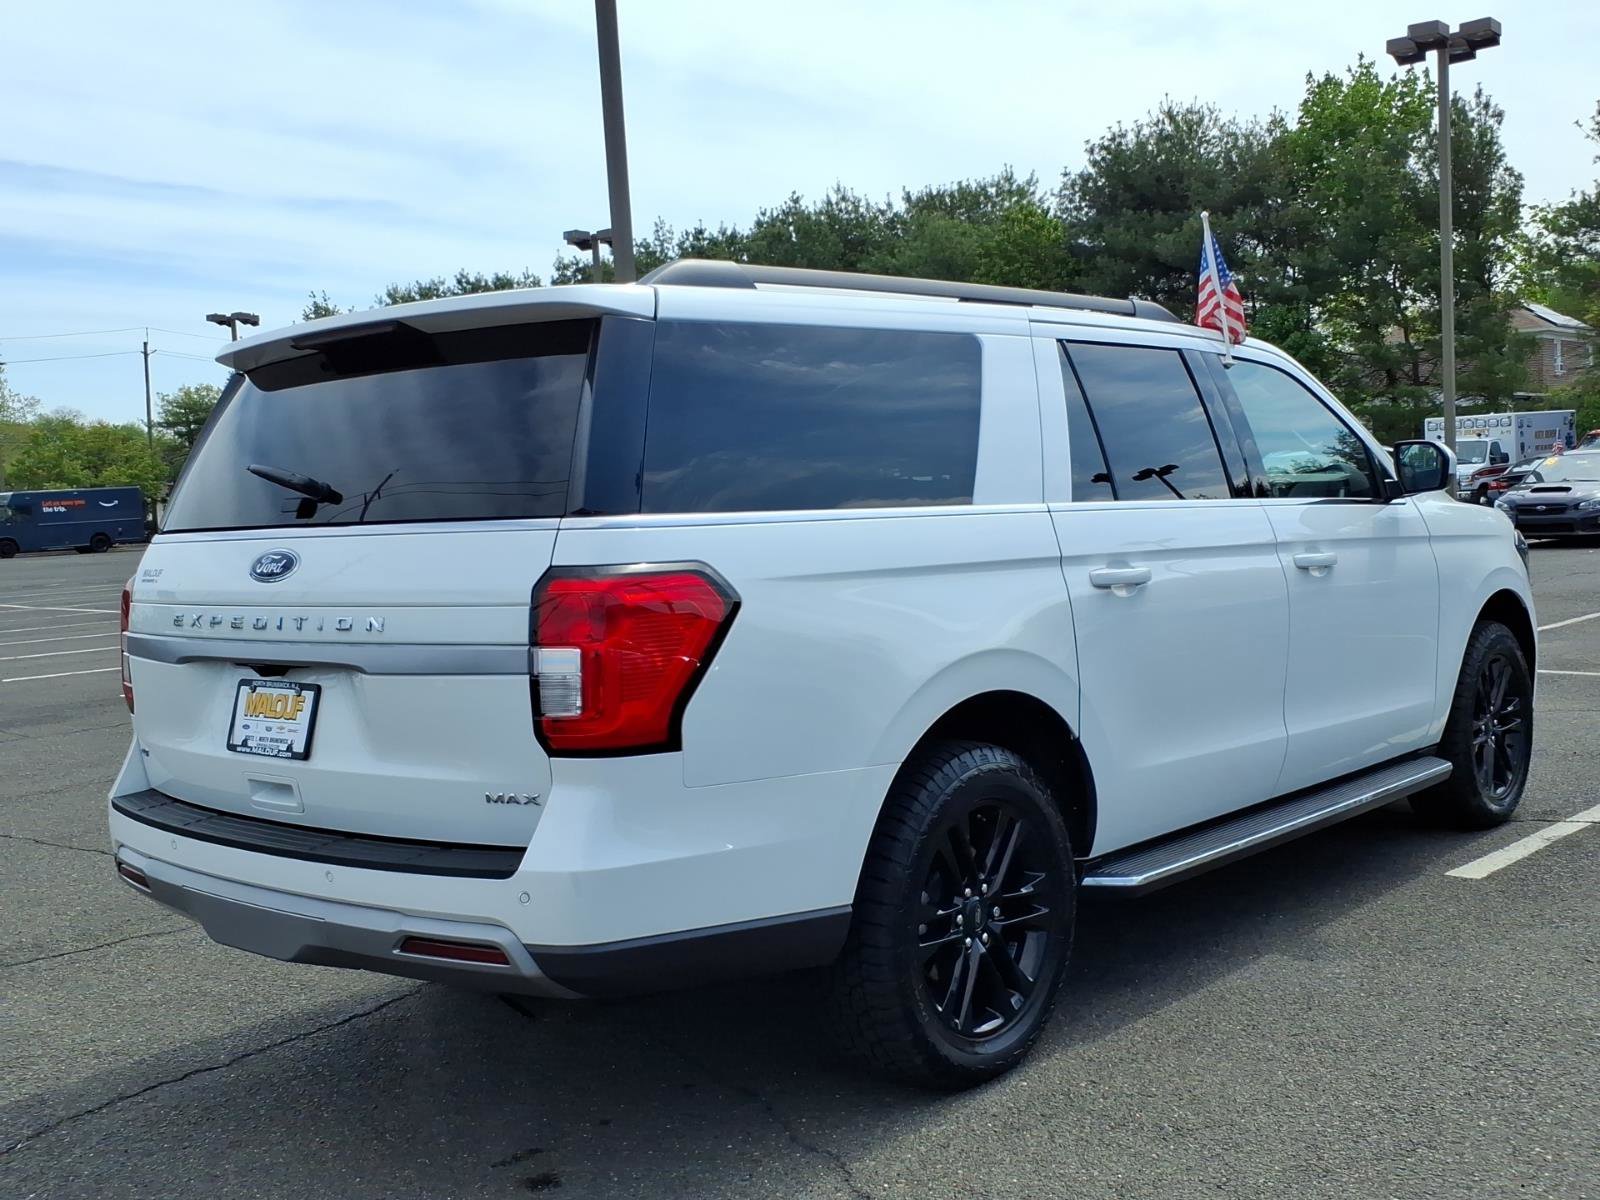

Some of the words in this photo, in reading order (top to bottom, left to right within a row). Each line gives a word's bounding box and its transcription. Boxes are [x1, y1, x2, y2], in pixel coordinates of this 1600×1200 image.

[173, 614, 386, 632] EXPEDITION
[243, 692, 306, 721] MALOUF
[236, 746, 292, 758] www.MALOUF.com
[485, 792, 541, 806] MAX
